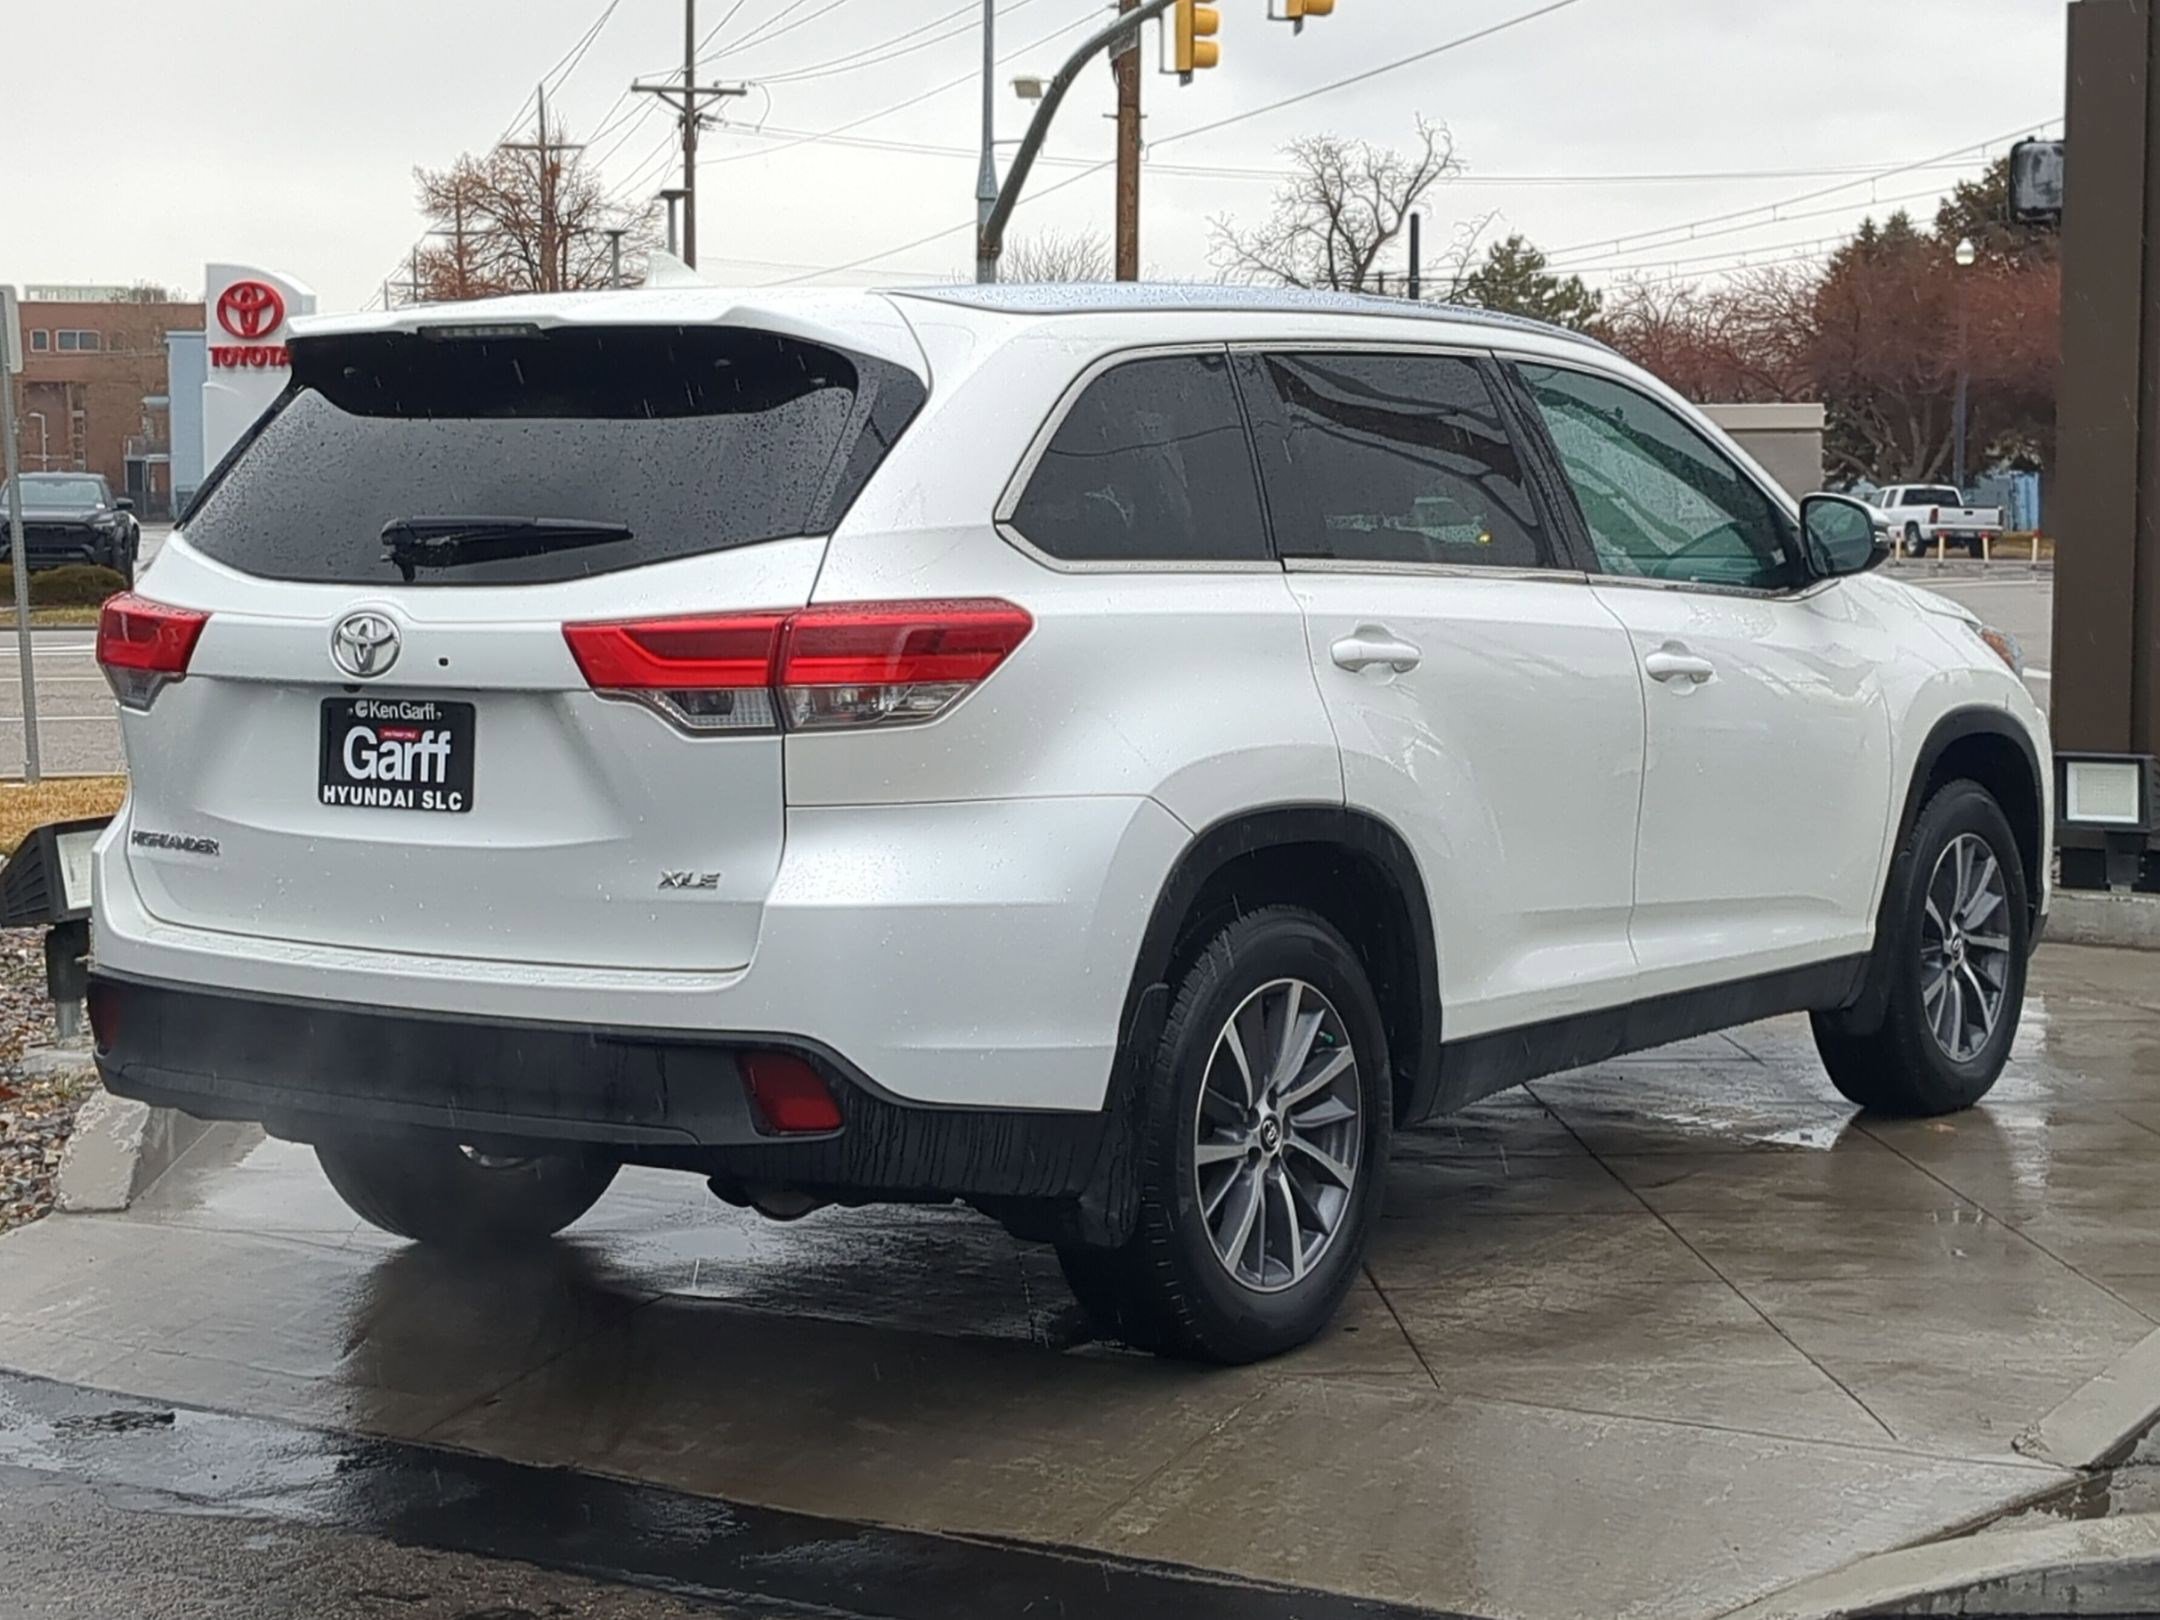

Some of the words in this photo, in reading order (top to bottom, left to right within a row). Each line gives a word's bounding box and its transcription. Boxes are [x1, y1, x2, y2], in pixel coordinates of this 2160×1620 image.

[208, 345, 291, 368] TOYOTA
[343, 726, 451, 783] Garff
[323, 785, 413, 807] HYUNDAI
[422, 790, 462, 810] SLC
[131, 829, 220, 856] HIGHLANDER
[658, 871, 721, 889] XLE
